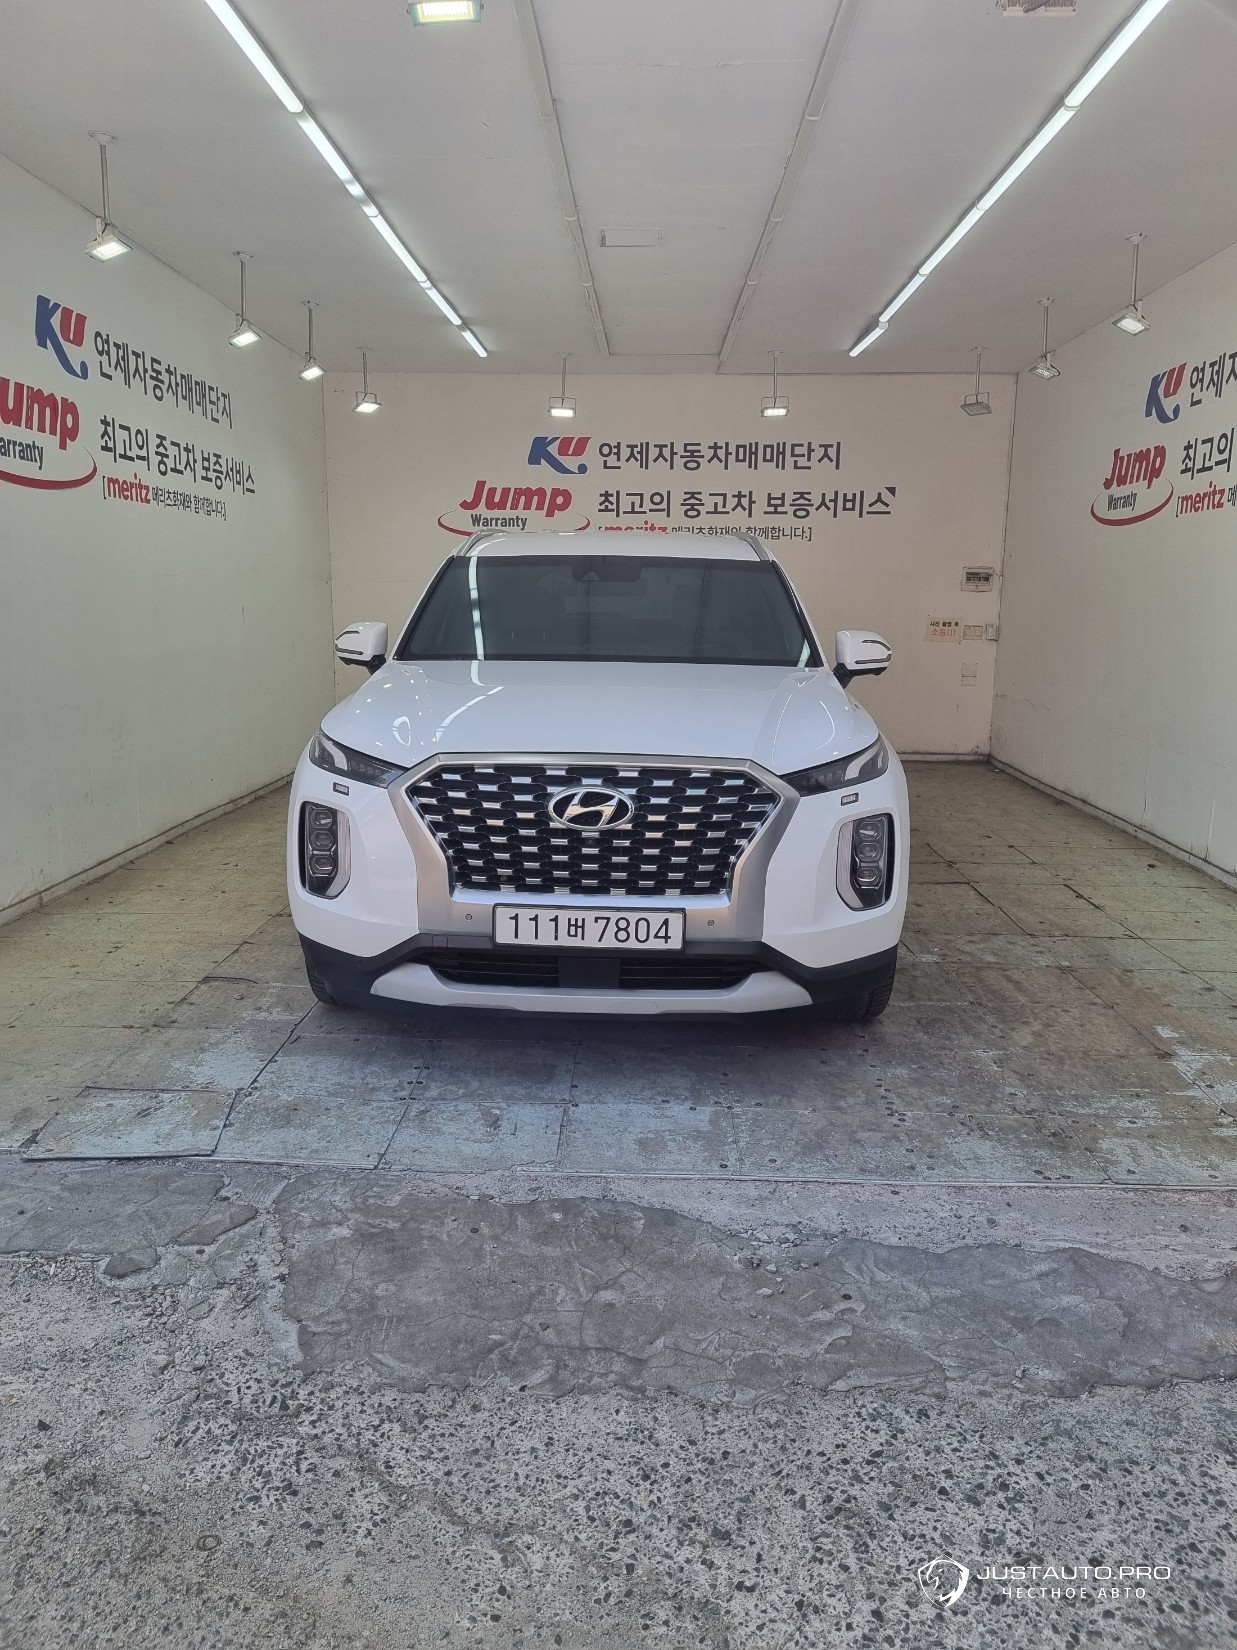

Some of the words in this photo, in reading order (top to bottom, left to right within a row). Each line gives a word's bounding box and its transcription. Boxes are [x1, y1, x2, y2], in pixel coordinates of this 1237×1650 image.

[94, 330, 233, 429] 연제자동차매매단지
[0, 376, 80, 451] ump
[0, 437, 44, 470] arranty
[100, 415, 151, 471] 최고의
[155, 433, 197, 483] 중고차
[201, 449, 256, 495] 보증서비스
[598, 441, 842, 472] 연제자동차매매단지
[1103, 445, 1167, 490] Jump
[1180, 427, 1235, 480] 최고의
[459, 480, 573, 518] Jump
[597, 490, 671, 518] 최고의
[680, 490, 757, 519] 중고차
[763, 490, 892, 519] 보증서비스
[1107, 491, 1138, 512] Warranty
[470, 513, 528, 531] Warranty
